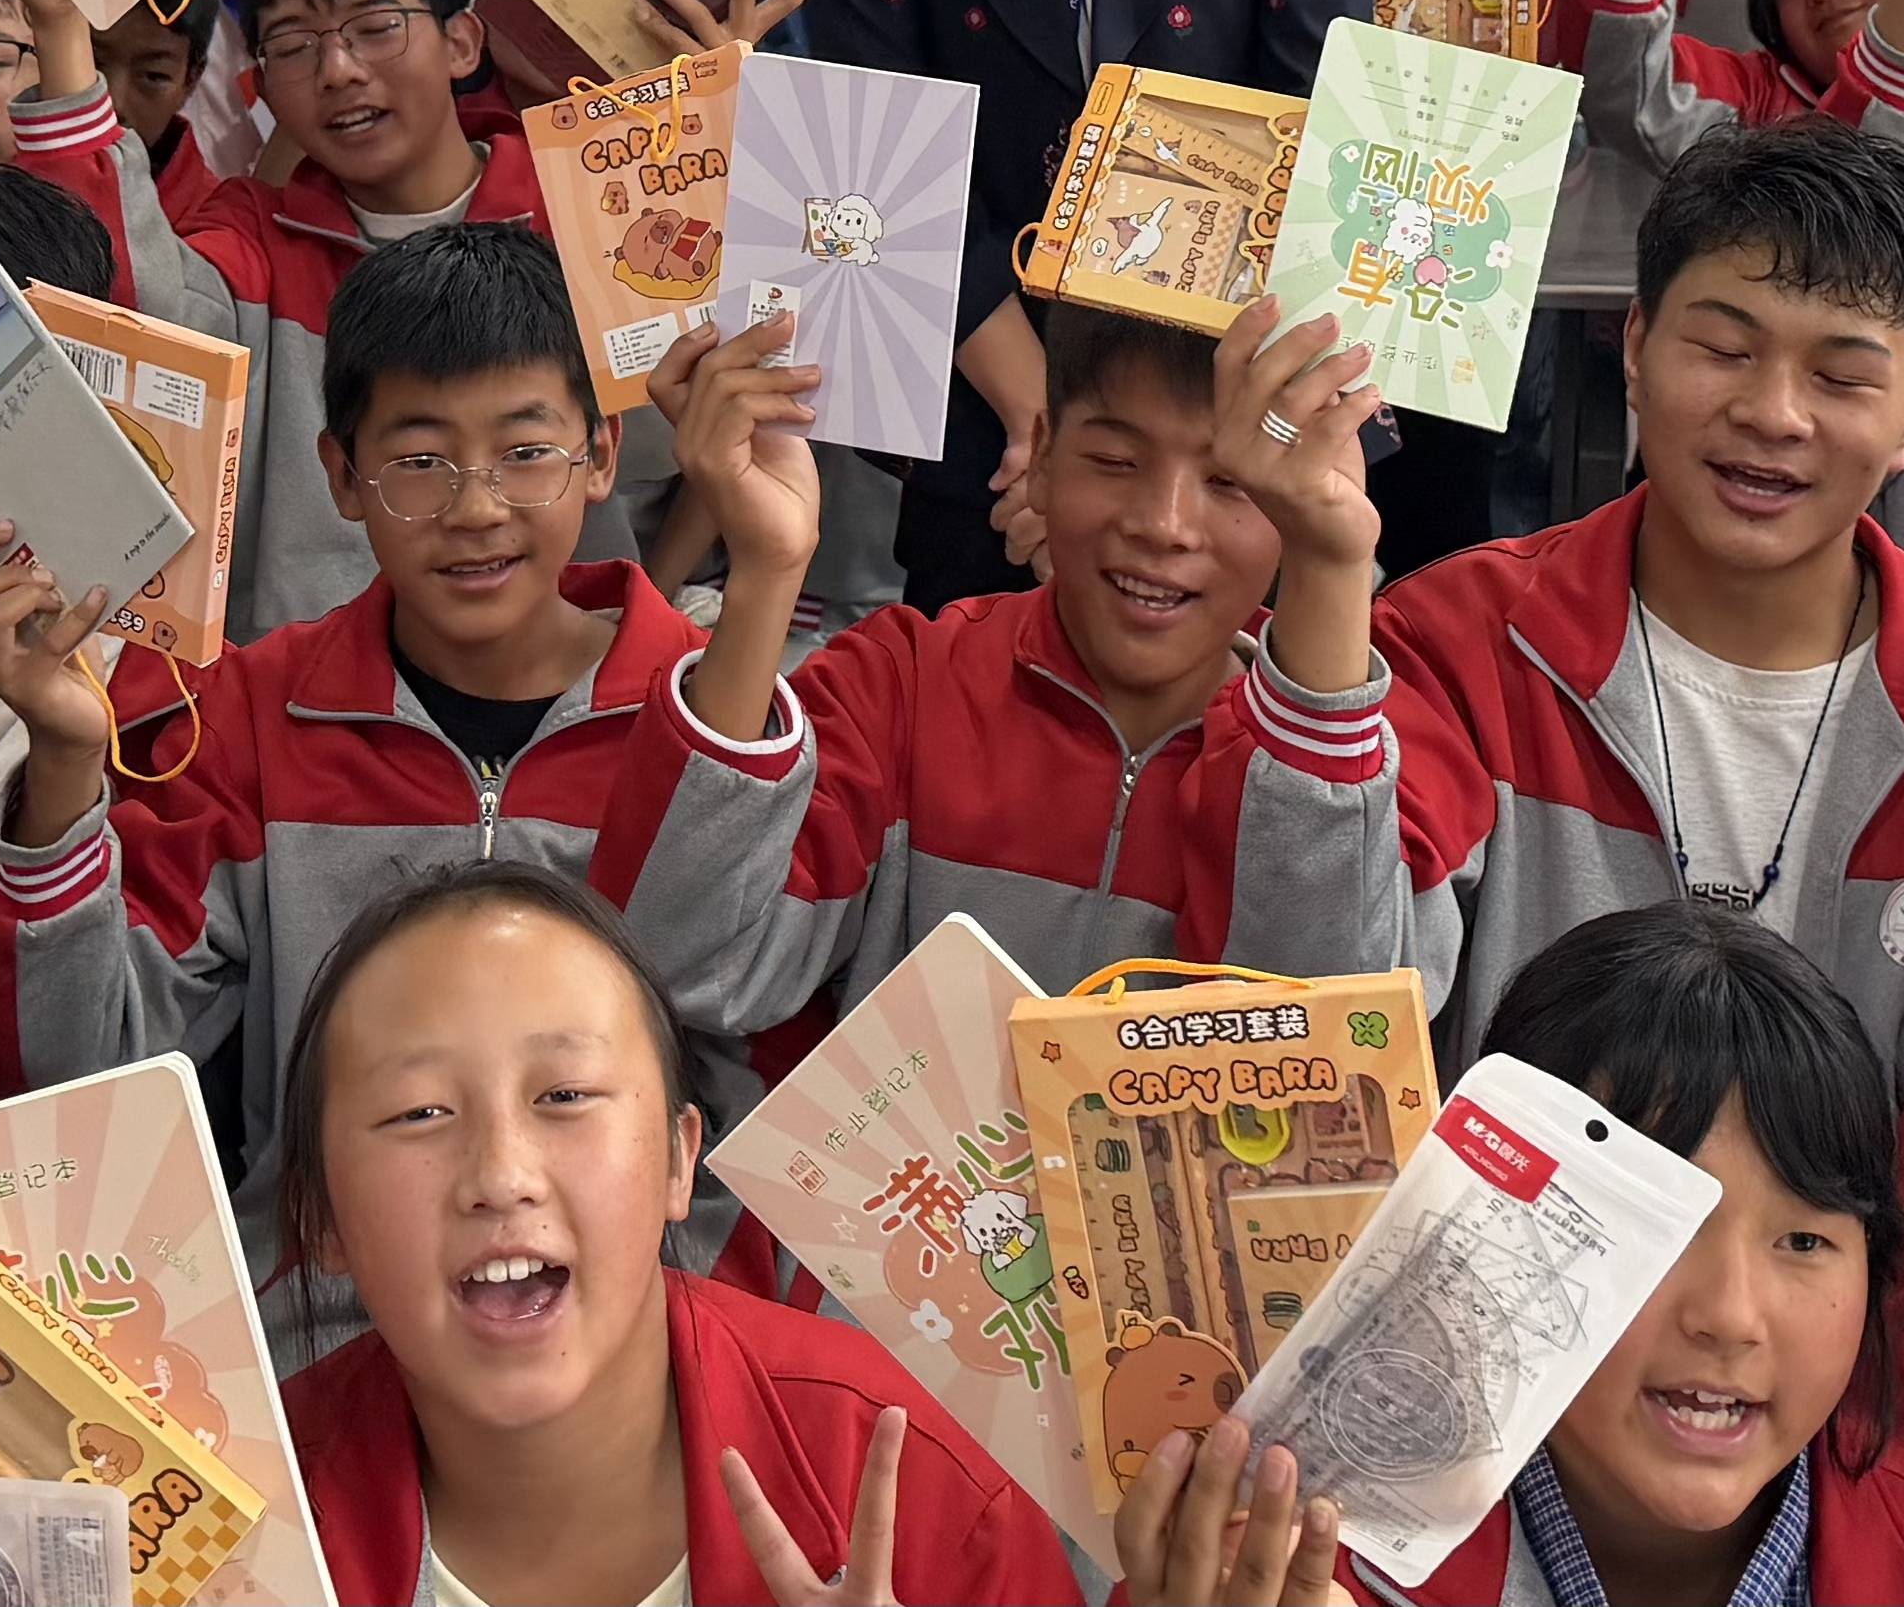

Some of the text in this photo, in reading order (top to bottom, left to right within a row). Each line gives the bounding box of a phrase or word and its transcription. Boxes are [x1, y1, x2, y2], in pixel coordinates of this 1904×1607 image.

[639, 149, 729, 196] BARA
[1358, 143, 1494, 225] 烦恼
[1117, 1005, 1310, 1051] 6合1学习套装
[824, 1048, 931, 1155] 作业登记本
[1109, 1056, 1338, 1107] CAPY BARA
[1250, 1234, 1328, 1265] BARA
[41, 1250, 140, 1318] 心
[61, 1329, 118, 1385] BARA
[129, 1467, 204, 1575] ARA
